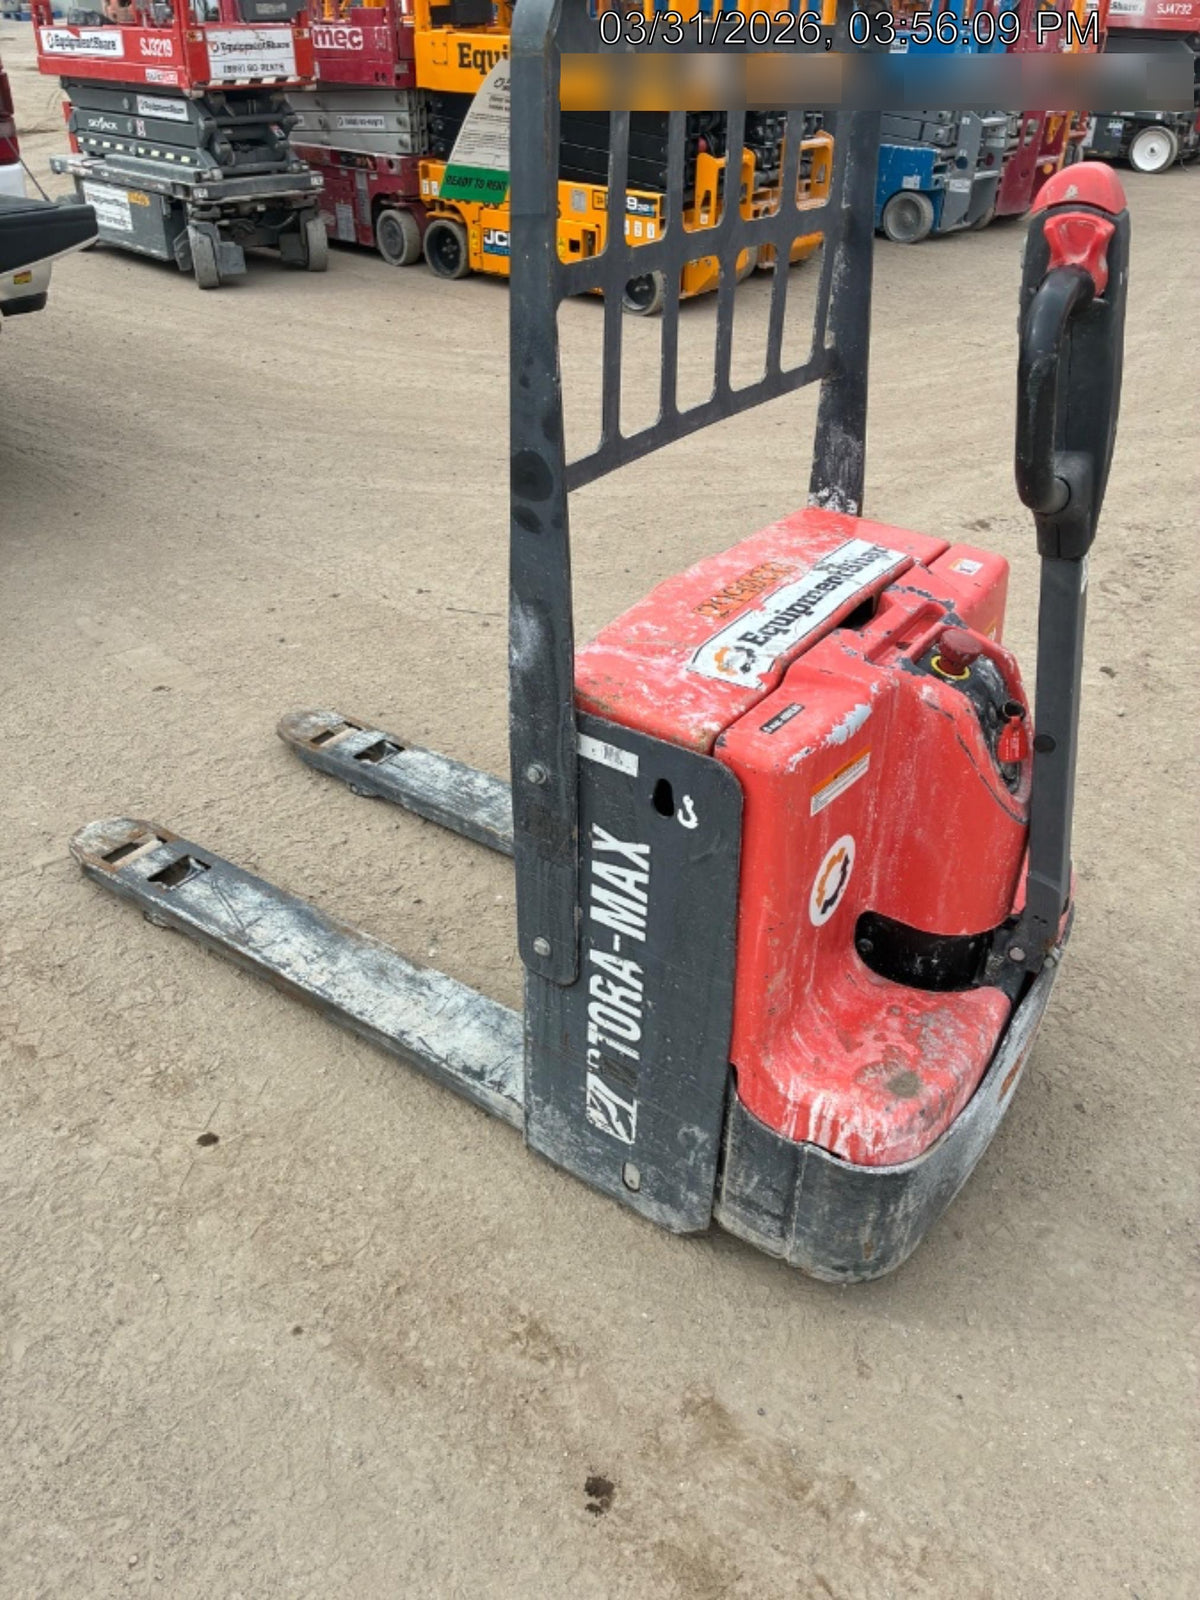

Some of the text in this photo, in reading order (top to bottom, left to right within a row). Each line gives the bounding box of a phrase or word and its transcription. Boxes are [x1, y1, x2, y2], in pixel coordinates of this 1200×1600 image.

[139, 37, 173, 57] SJ3219
[313, 29, 362, 48] mec
[484, 229, 511, 247] JC
